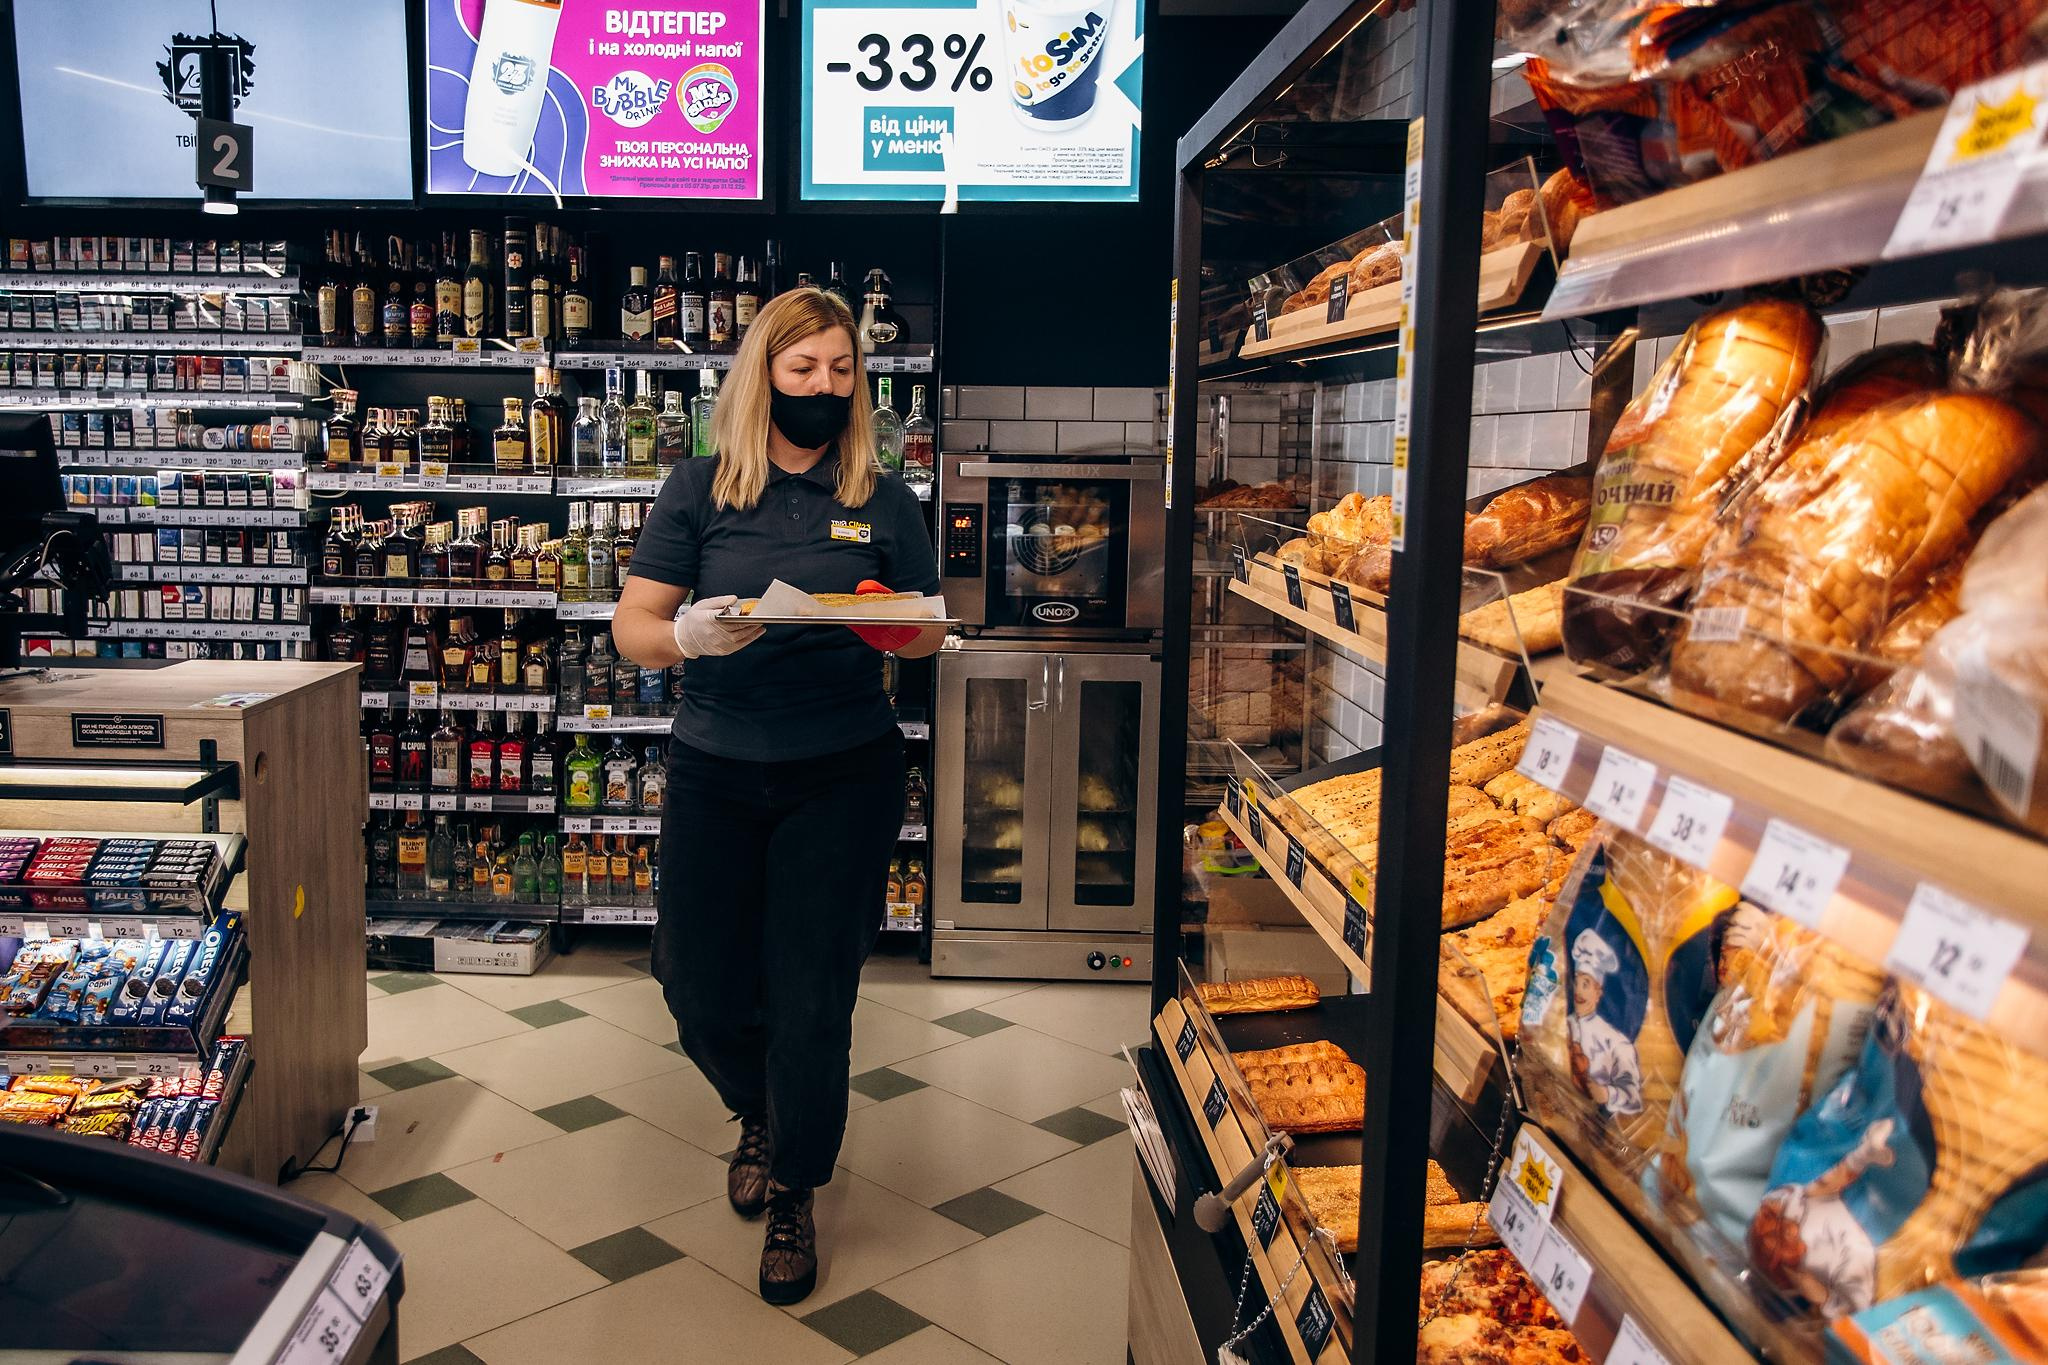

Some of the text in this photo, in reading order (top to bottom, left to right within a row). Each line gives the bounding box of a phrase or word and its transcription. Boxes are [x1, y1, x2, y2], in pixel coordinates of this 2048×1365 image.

[605, 10, 727, 37] ВІДТЕПЕР
[589, 39, 743, 60] і на холодні напої
[827, 33, 993, 92] -33%
[594, 80, 670, 116] BUBBLE
[625, 104, 661, 121] DRINK
[870, 115, 948, 137] від ціни
[615, 141, 749, 155] ТВОЯ ПЕРСОНАЛЬНА
[871, 139, 944, 158] у меню
[212, 134, 240, 179] 2
[599, 155, 658, 168] ЗНИЖКА
[661, 157, 680, 168] НА
[683, 157, 703, 169] УСІ
[905, 434, 933, 443] ПЕРВАК
[1038, 607, 1071, 616] UNOX
[401, 741, 426, 751] AL CAPONE
[1536, 748, 1550, 771] 18
[1608, 779, 1624, 802] 14
[1671, 812, 1693, 842] 38
[50, 837, 82, 845] HALLS
[108, 839, 139, 847] HALLS
[46, 845, 77, 853] HALLS
[103, 846, 134, 854] HALLS
[36, 861, 68, 870] HALLS
[99, 855, 130, 863] HALLS
[32, 870, 64, 878] HALLS
[95, 863, 126, 871] HALLS
[1777, 867, 1799, 896] 14
[62, 926, 73, 935] 12
[116, 927, 127, 936] 12
[172, 928, 184, 937] 12
[198, 930, 223, 976] OREO
[1929, 936, 1962, 978] 12
[27, 1064, 33, 1072] 9
[93, 1065, 99, 1073] 9
[149, 1064, 162, 1073] 22
[205, 1069, 224, 1098] KitKat
[1503, 1205, 1517, 1232] 14
[1550, 1263, 1566, 1291] 16
[355, 1273, 373, 1298] 63
[320, 1326, 340, 1353] 35
